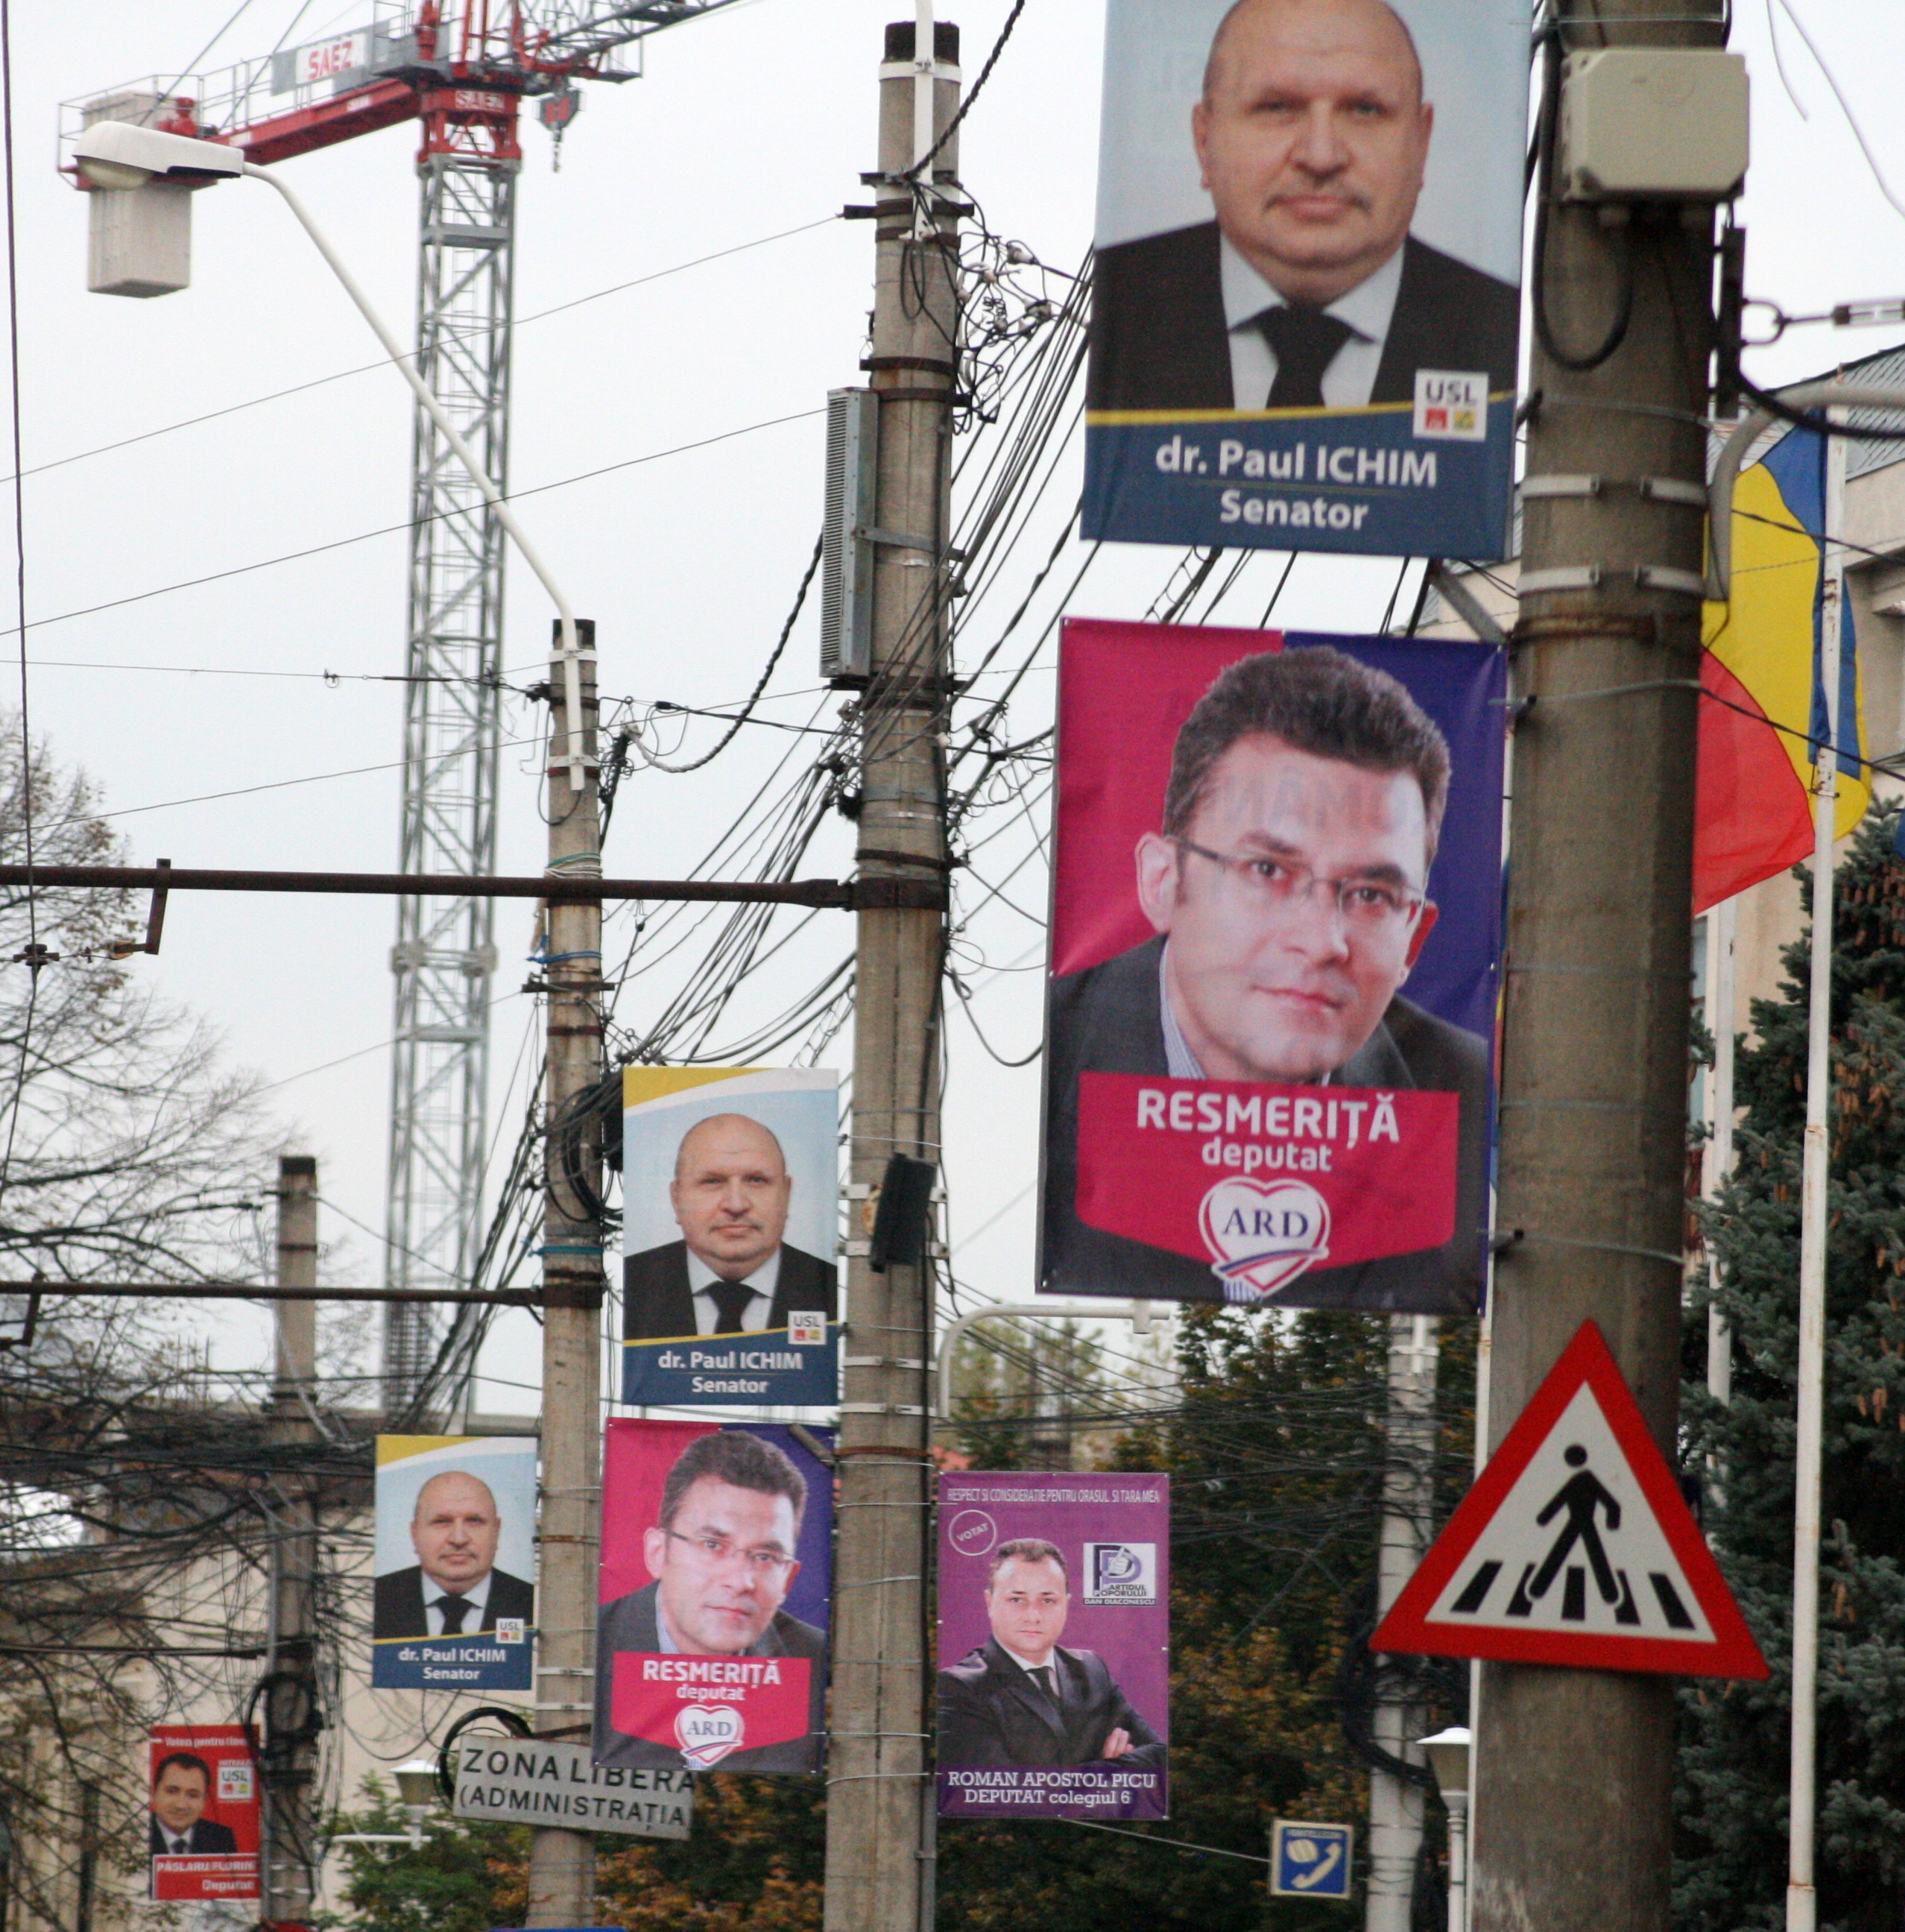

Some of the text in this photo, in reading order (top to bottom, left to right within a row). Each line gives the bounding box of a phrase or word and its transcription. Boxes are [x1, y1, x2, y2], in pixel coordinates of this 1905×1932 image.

[308, 40, 353, 80] SAEZ
[1426, 379, 1477, 405] USL
[1155, 435, 1436, 487] dr. Paul ICHIM
[1219, 488, 1370, 531] Senator
[1201, 1136, 1333, 1173] deputat
[1222, 1208, 1310, 1239] ARD
[793, 1315, 821, 1328] USL
[658, 1350, 803, 1370] dr. Paul ICHIM
[692, 1376, 769, 1394] Senator
[499, 1621, 520, 1631] USL
[398, 1647, 506, 1662] dr. Paul ICHIM
[423, 1667, 481, 1680] Senator
[676, 1684, 746, 1703] deputat
[686, 1720, 733, 1737] ARD
[463, 1748, 560, 1781] ZONA
[222, 1770, 247, 1781] USL
[948, 1771, 1156, 1788] ROMAN APOSTOL PICU
[964, 1789, 1131, 1808] DEPUTAT colegiul 6
[202, 1878, 256, 1892] Deputat
